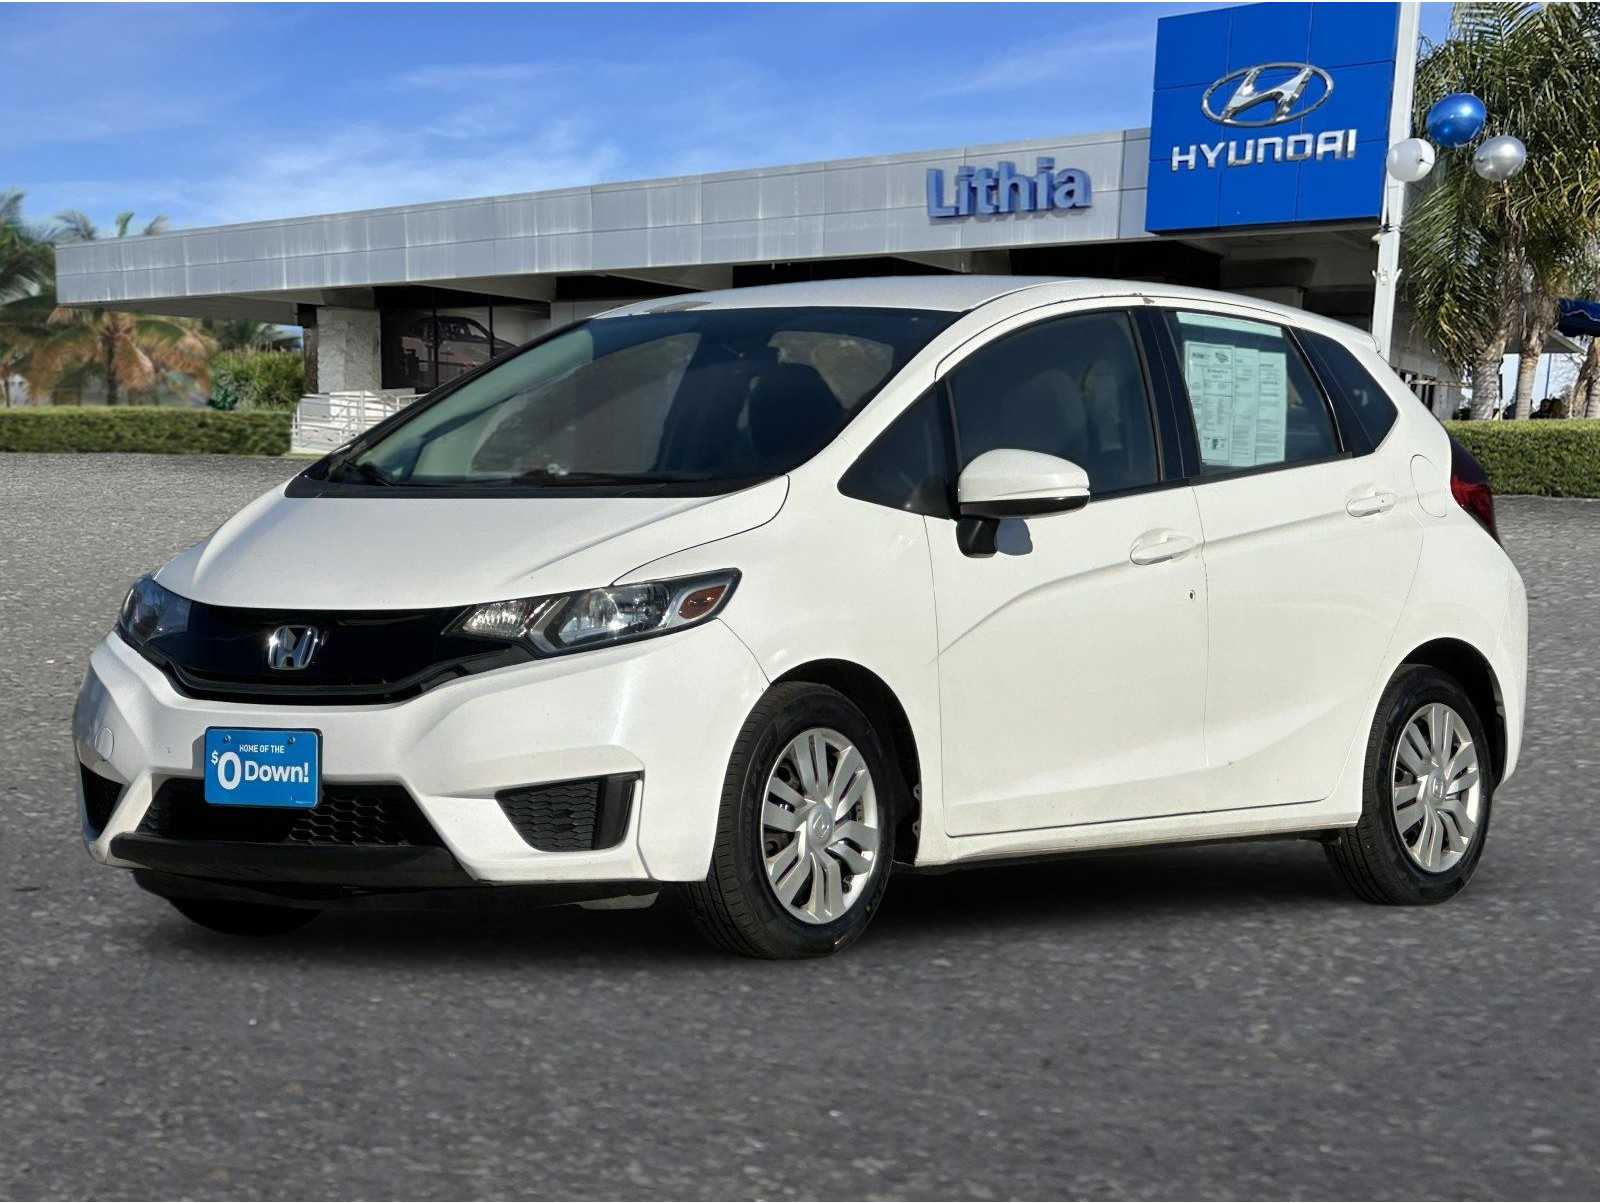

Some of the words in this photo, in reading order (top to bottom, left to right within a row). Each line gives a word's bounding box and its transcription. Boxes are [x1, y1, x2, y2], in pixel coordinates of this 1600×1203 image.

[1171, 128, 1357, 172] HYUNDAI
[926, 156, 1092, 218] Lithia
[239, 744, 259, 753] HOME
[259, 744, 269, 753] OF
[270, 744, 285, 754] THE
[244, 760, 309, 783] Down!
